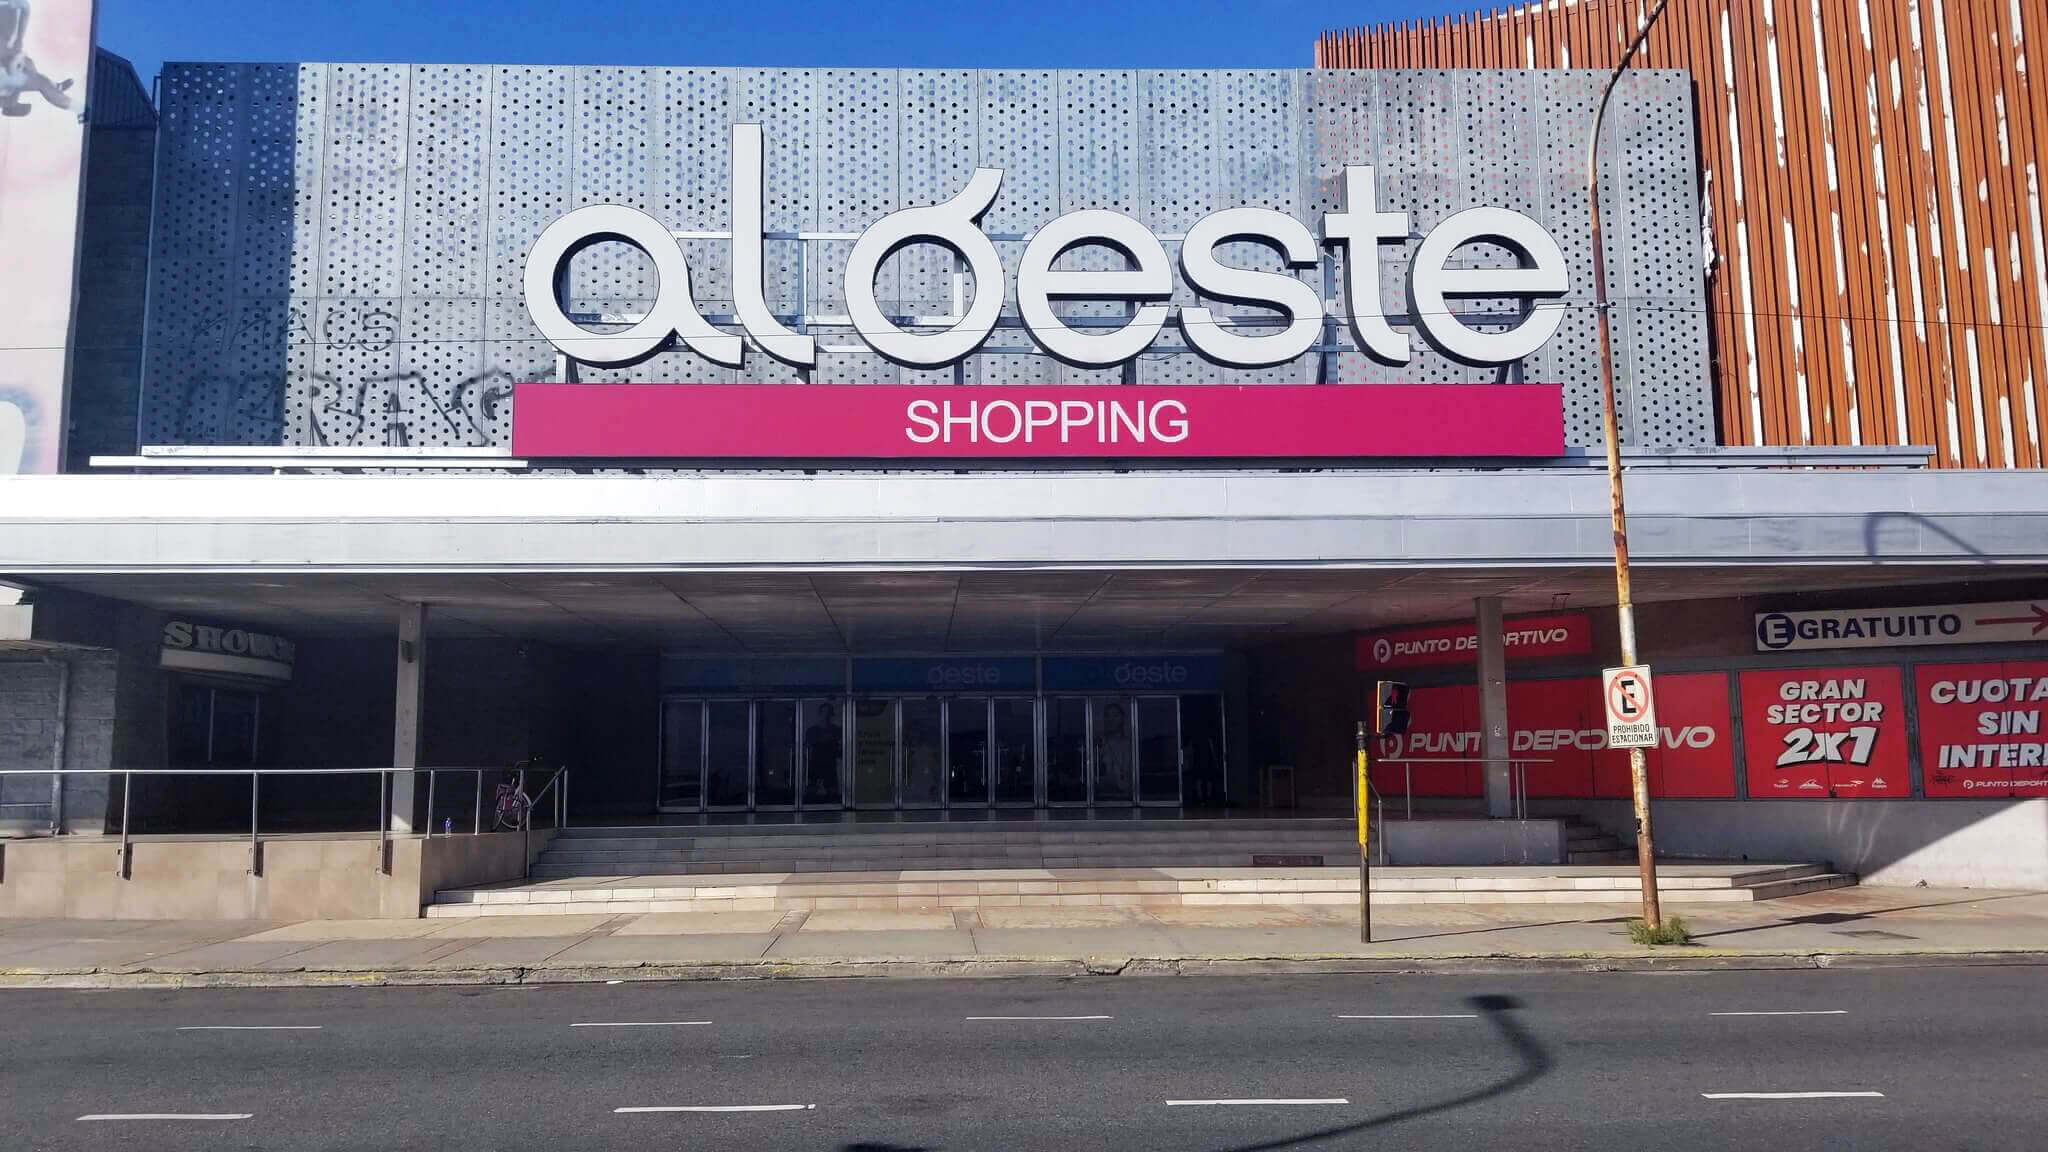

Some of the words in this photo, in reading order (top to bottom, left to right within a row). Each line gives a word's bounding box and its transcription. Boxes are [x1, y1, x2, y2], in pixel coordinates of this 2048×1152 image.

[905, 400, 1189, 443] SHOPPING
[1797, 613, 1961, 640] GRATUITO
[1394, 638, 1451, 656] PUNTO
[1455, 628, 1568, 651] DERTIVO
[1779, 679, 1865, 701] GRAN
[1766, 702, 1883, 724] SECTOR
[1977, 710, 2039, 735] SIN
[1611, 732, 1654, 744] ESTACIONAR
[1613, 723, 1650, 734] PROHIBIDO
[1409, 731, 1482, 752] PUNT
[1975, 780, 2009, 788] PUNTO
